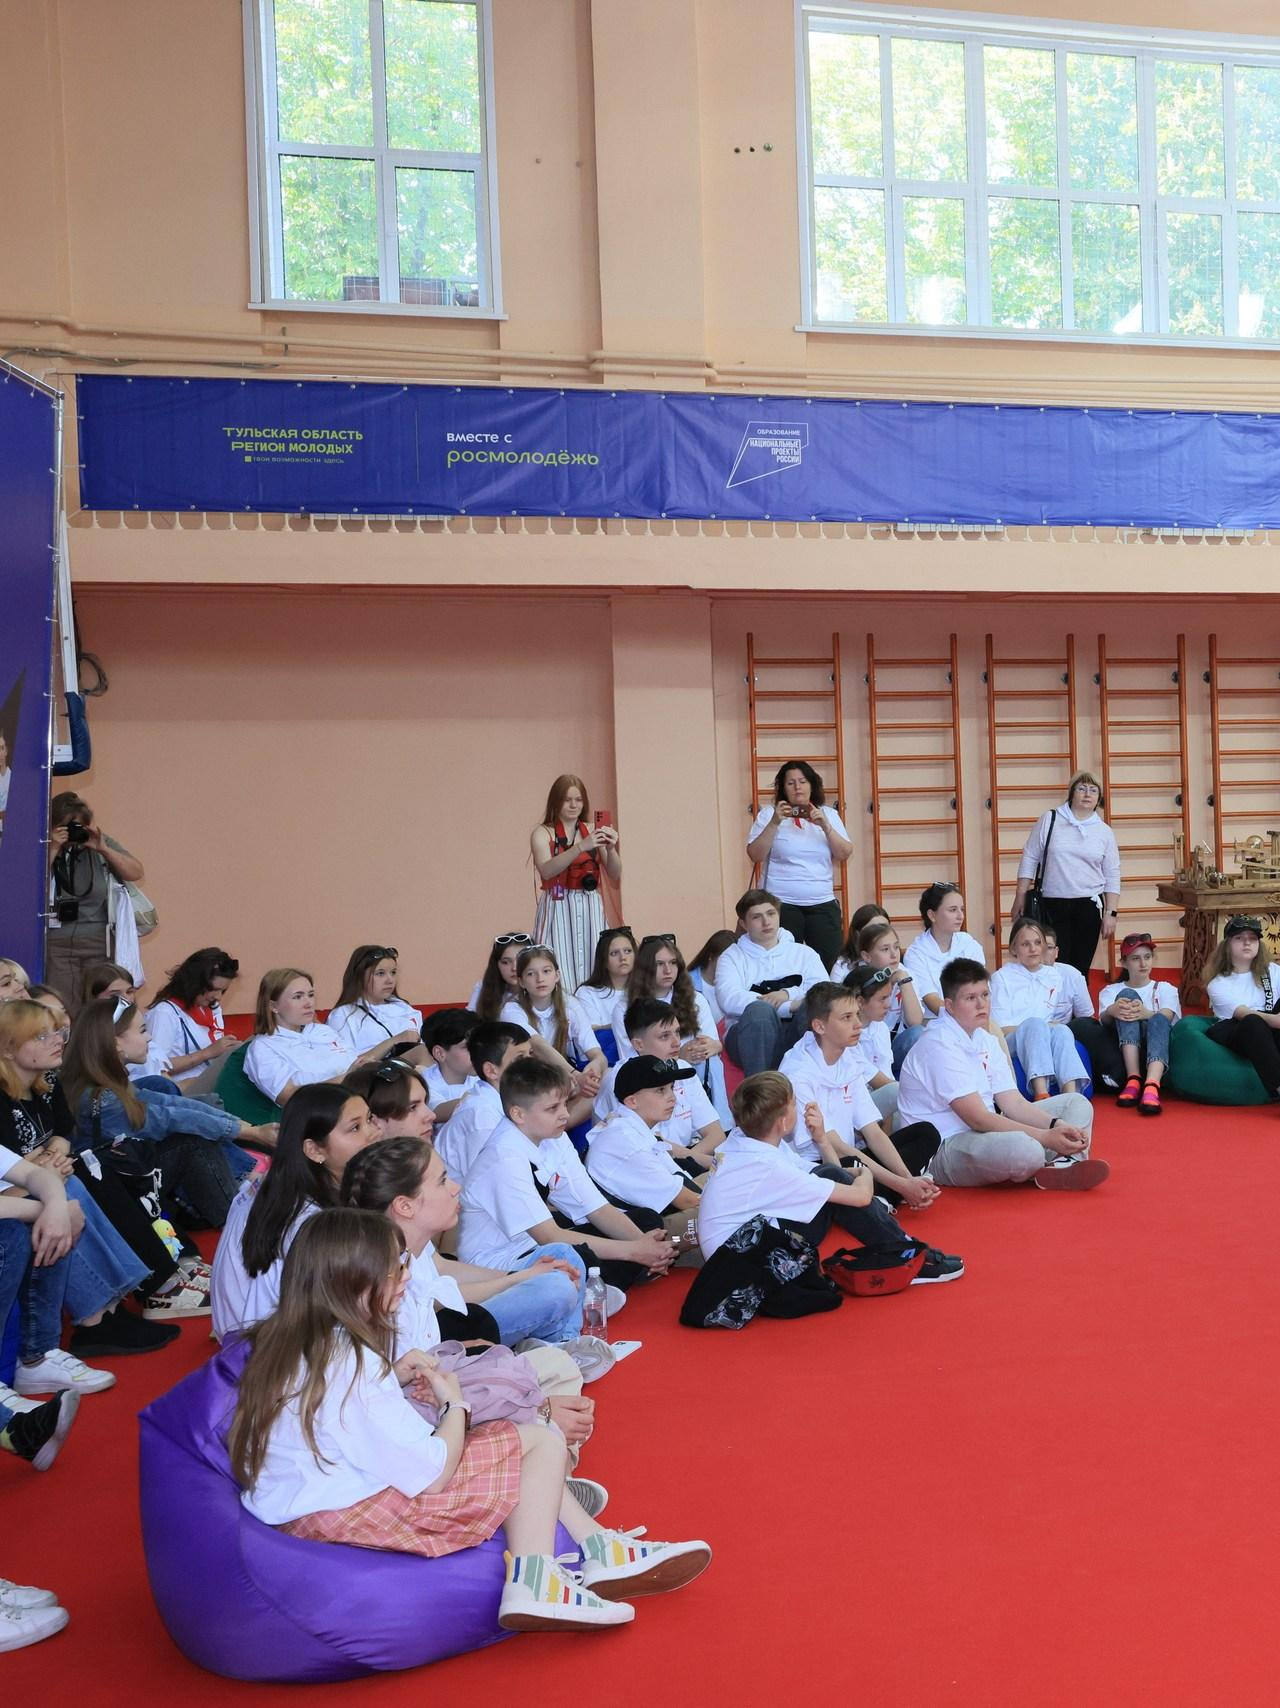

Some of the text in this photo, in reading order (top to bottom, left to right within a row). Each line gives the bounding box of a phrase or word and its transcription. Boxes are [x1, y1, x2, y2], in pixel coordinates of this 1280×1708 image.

[222, 427, 363, 440] ТУЛЬСКАЯ ОБЛАСТЬ
[446, 432, 512, 443] вместе с
[231, 442, 353, 455] РЕГИОН МОЛОДЫХ
[749, 440, 799, 448] НАЦИОНАЛЬНЫЕ
[447, 449, 599, 468] росмолодёжь
